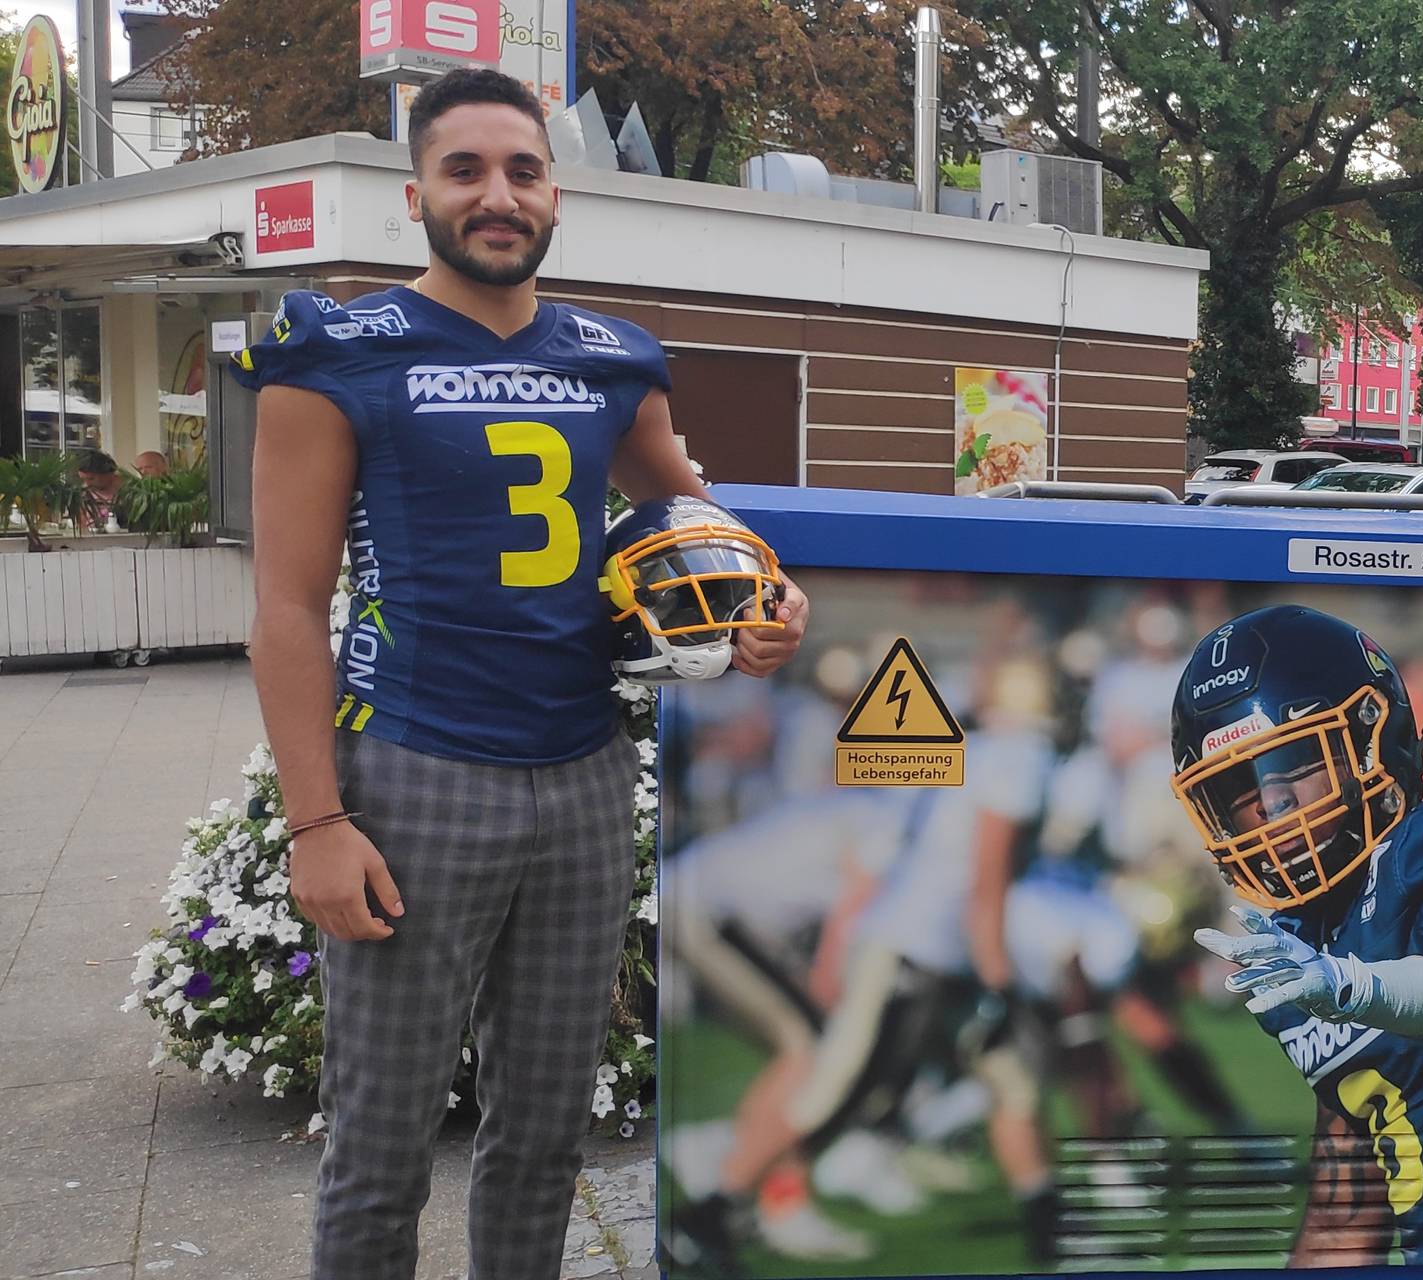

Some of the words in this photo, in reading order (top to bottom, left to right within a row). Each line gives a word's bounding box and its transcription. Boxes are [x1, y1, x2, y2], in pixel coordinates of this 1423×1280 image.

[271, 214, 312, 239] Sparkasse
[581, 325, 617, 342] GFL
[484, 421, 580, 588] 3
[1314, 546, 1412, 569] Rosastr.
[1193, 666, 1250, 699] innogy
[1207, 719, 1261, 751] Riddell
[848, 752, 952, 767] Hochspannung
[853, 768, 947, 781] Lebensgefahr
